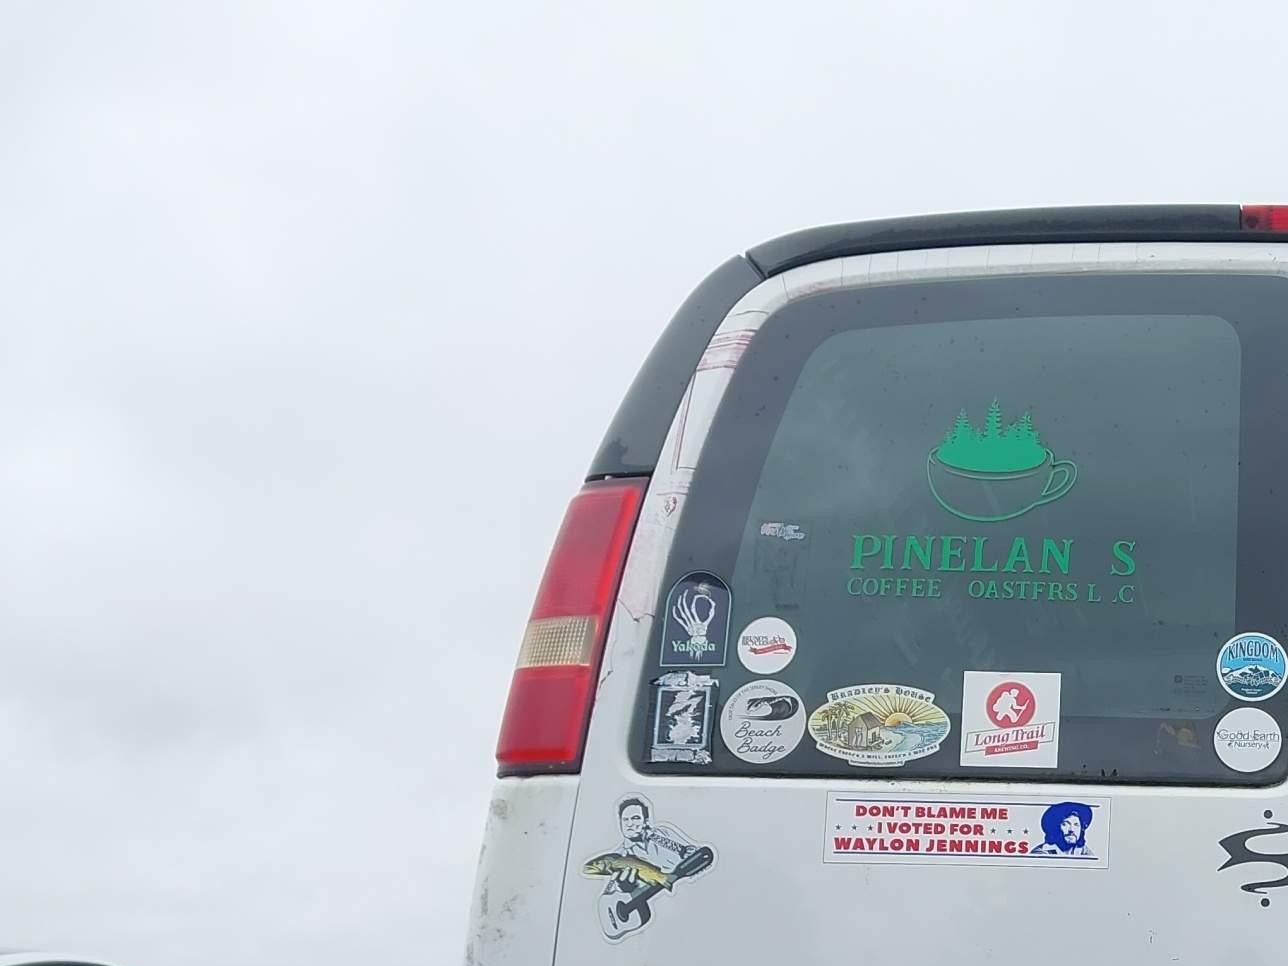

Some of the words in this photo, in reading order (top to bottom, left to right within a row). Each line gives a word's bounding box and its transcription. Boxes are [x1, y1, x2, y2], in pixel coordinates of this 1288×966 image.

[847, 577, 942, 598] COFFEE
[671, 640, 716, 653] Yakoda
[1227, 640, 1279, 663] KINGDOM
[735, 721, 782, 738] Beach
[974, 731, 1010, 747] Long
[1011, 725, 1046, 742] Trail
[1218, 729, 1250, 740] Good
[1253, 730, 1280, 741] Earth
[737, 738, 785, 759] Badge
[1234, 740, 1262, 750] Nursery
[855, 805, 911, 818] DON'T
[915, 806, 976, 819] BLAME
[980, 807, 1008, 820] ME
[877, 822, 882, 833] I
[886, 822, 945, 835] VOTED
[949, 823, 984, 836] FOR
[834, 837, 920, 852] WAYLON
[925, 839, 1029, 854] JENNINGS
